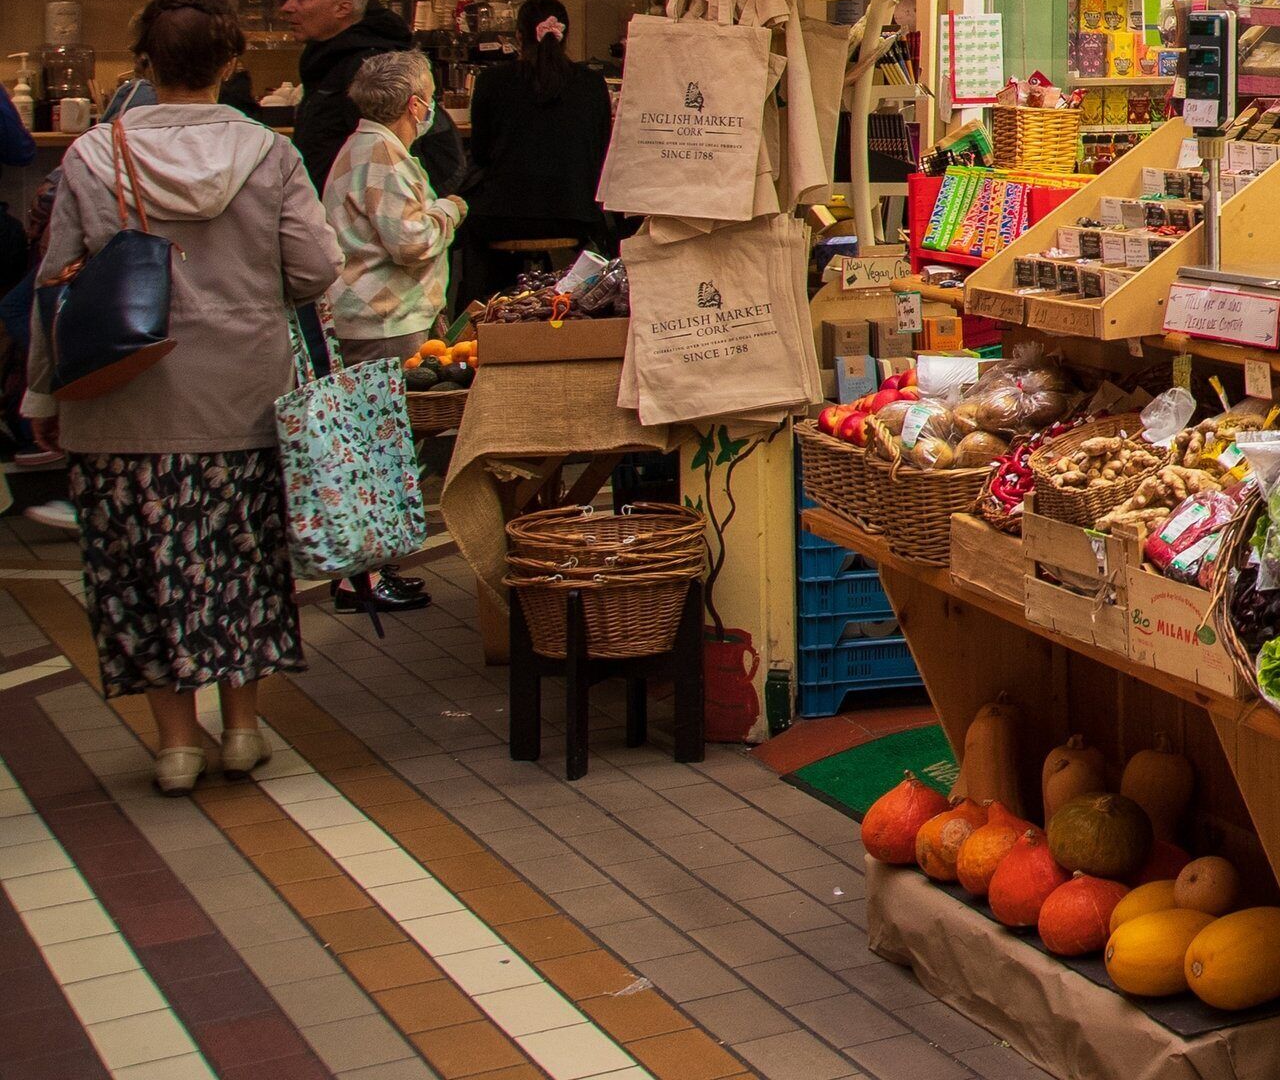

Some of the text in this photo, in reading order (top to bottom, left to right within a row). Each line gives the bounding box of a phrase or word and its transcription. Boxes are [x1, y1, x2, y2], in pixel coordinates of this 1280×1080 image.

[640, 111, 745, 129] ENGLISH MARKET
[676, 126, 704, 137] CORK
[660, 149, 714, 161] SINCE 1788
[651, 302, 773, 334] ENGLISH MARKET
[696, 323, 730, 338] CORK
[683, 344, 749, 364] SINCE 1788
